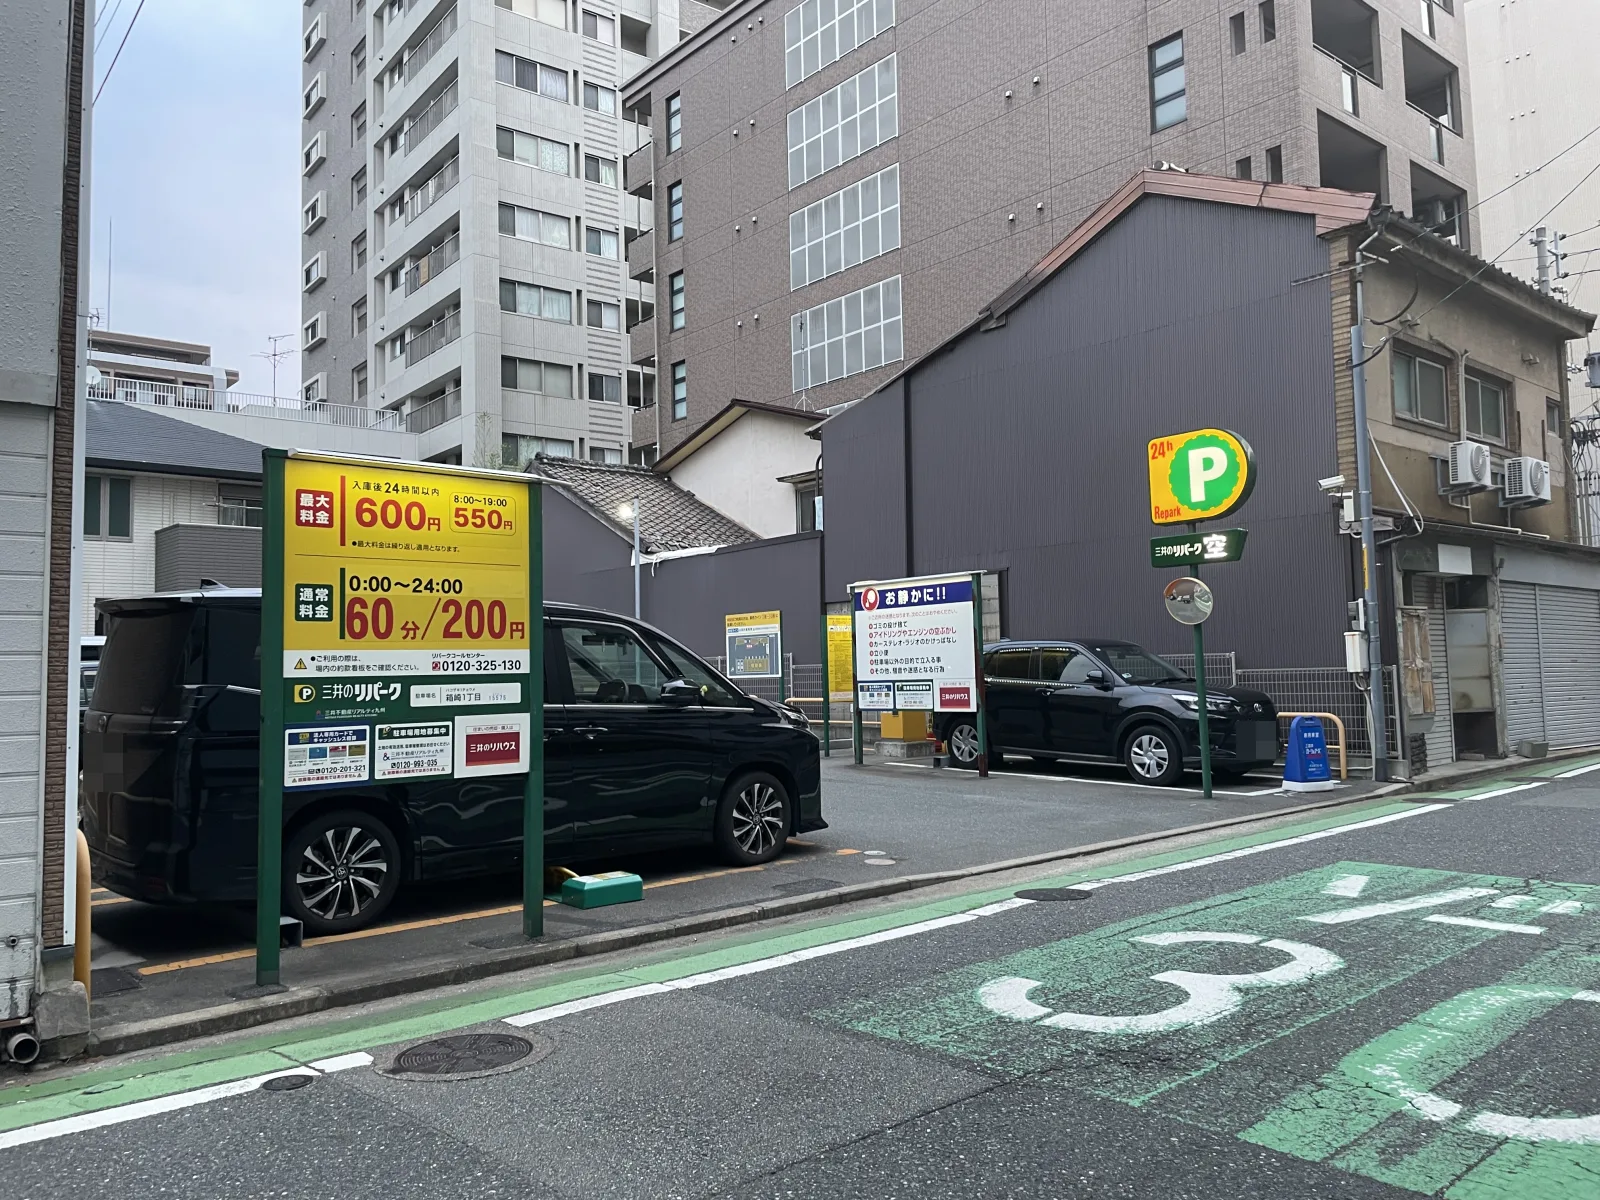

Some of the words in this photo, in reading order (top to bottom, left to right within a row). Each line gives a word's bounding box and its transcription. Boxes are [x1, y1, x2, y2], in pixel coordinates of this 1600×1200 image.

[1150, 440, 1173, 460] 24h
[1188, 446, 1228, 503] P
[352, 480, 441, 498] 入庫後24時間以内
[299, 493, 331, 508] 最大
[299, 508, 331, 526] 料金
[1154, 505, 1182, 521] Repark
[1155, 542, 1202, 557] 三井のリパーク
[1202, 534, 1228, 560] 空
[299, 587, 330, 602] 通常
[299, 603, 330, 619] 料金
[873, 626, 957, 639] アイドリングやエンジンの空ぶかし
[431, 652, 486, 660] リパークコールセンター
[442, 659, 522, 672] 0120-325-130
[322, 681, 402, 702] 三井のリパーク
[445, 693, 481, 702] 箱崎1丁目
[469, 741, 517, 753] 三井のリハウス
